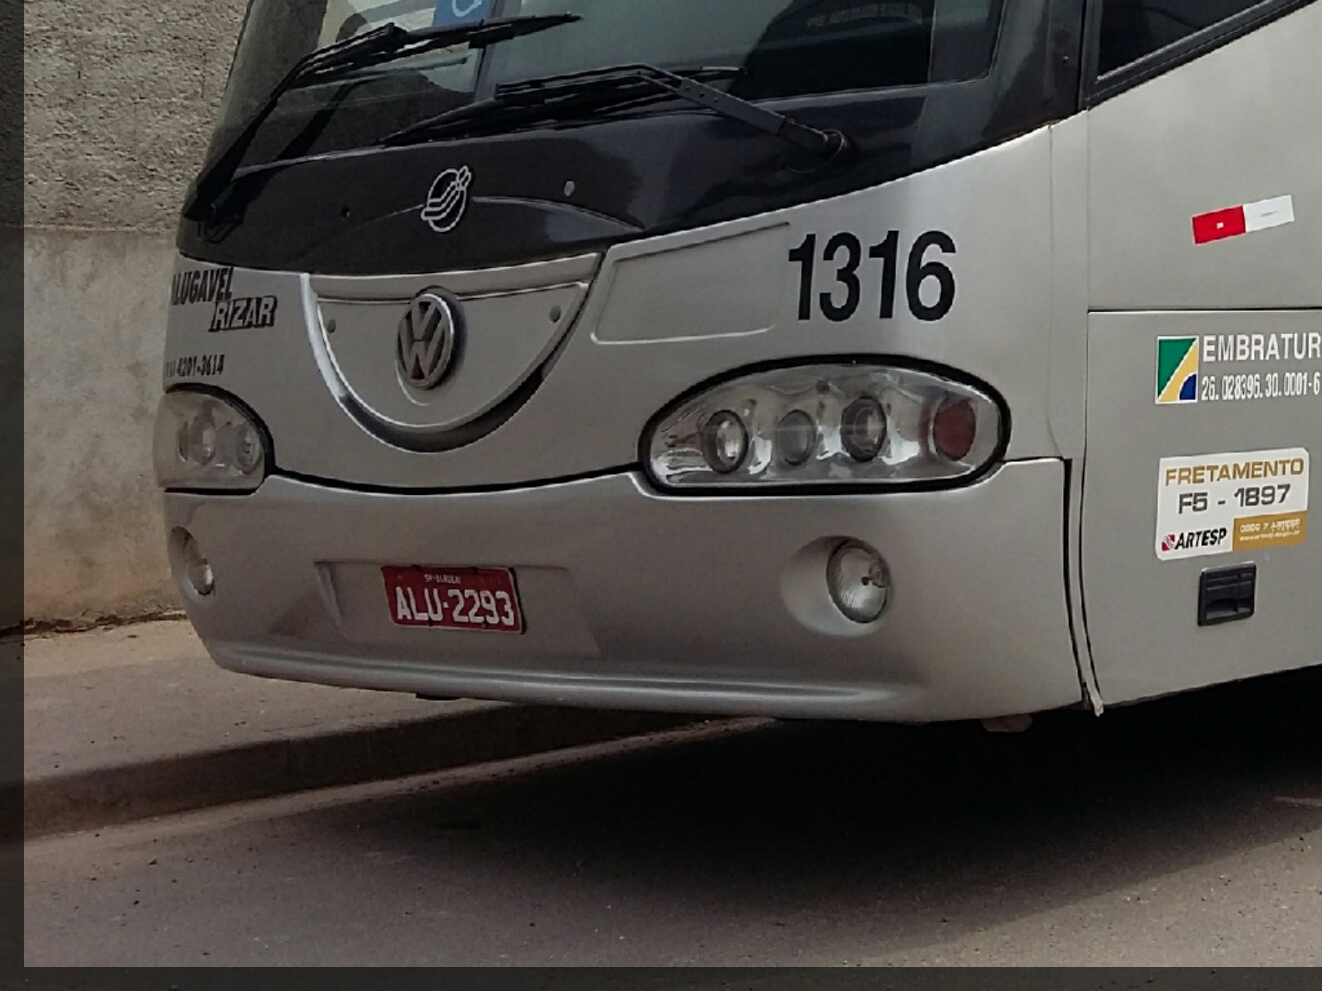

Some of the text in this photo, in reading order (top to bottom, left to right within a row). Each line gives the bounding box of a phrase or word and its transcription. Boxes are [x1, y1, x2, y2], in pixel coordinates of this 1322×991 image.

[787, 229, 957, 322] 1316
[1202, 332, 1322, 362] EMBRATUR
[1165, 457, 1305, 487] FRETAMENTO
[1178, 492, 1208, 515] F5
[1234, 483, 1291, 508] 1897
[1174, 527, 1228, 550] ARTESP
